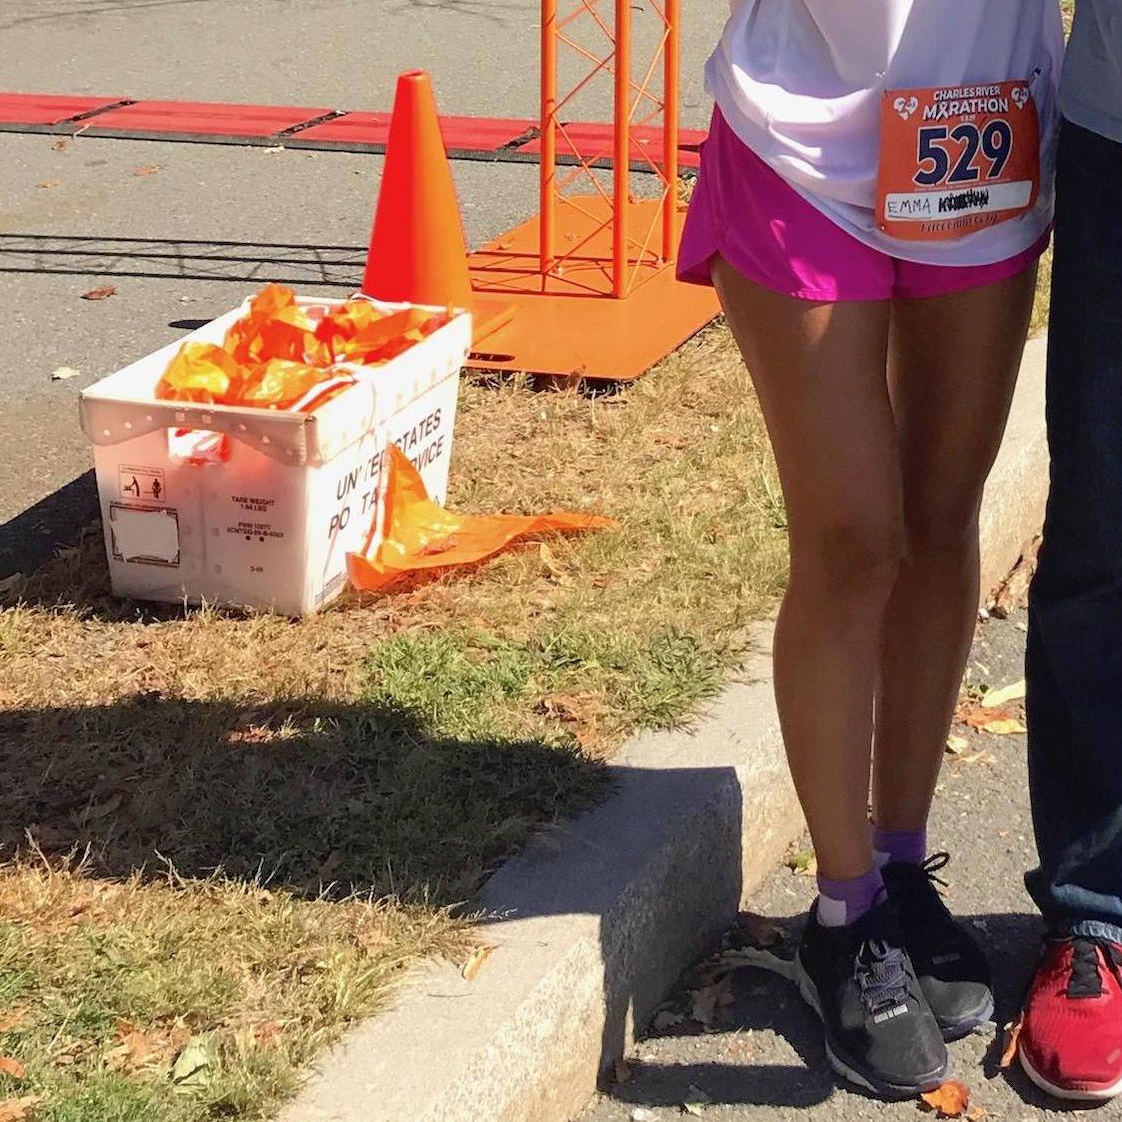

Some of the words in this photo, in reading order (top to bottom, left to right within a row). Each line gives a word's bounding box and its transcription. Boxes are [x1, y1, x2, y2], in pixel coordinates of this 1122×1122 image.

[933, 88, 975, 101] CHARLES
[976, 86, 1000, 97] RIVER
[912, 119, 1014, 187] 529
[887, 198, 932, 215] EMMA
